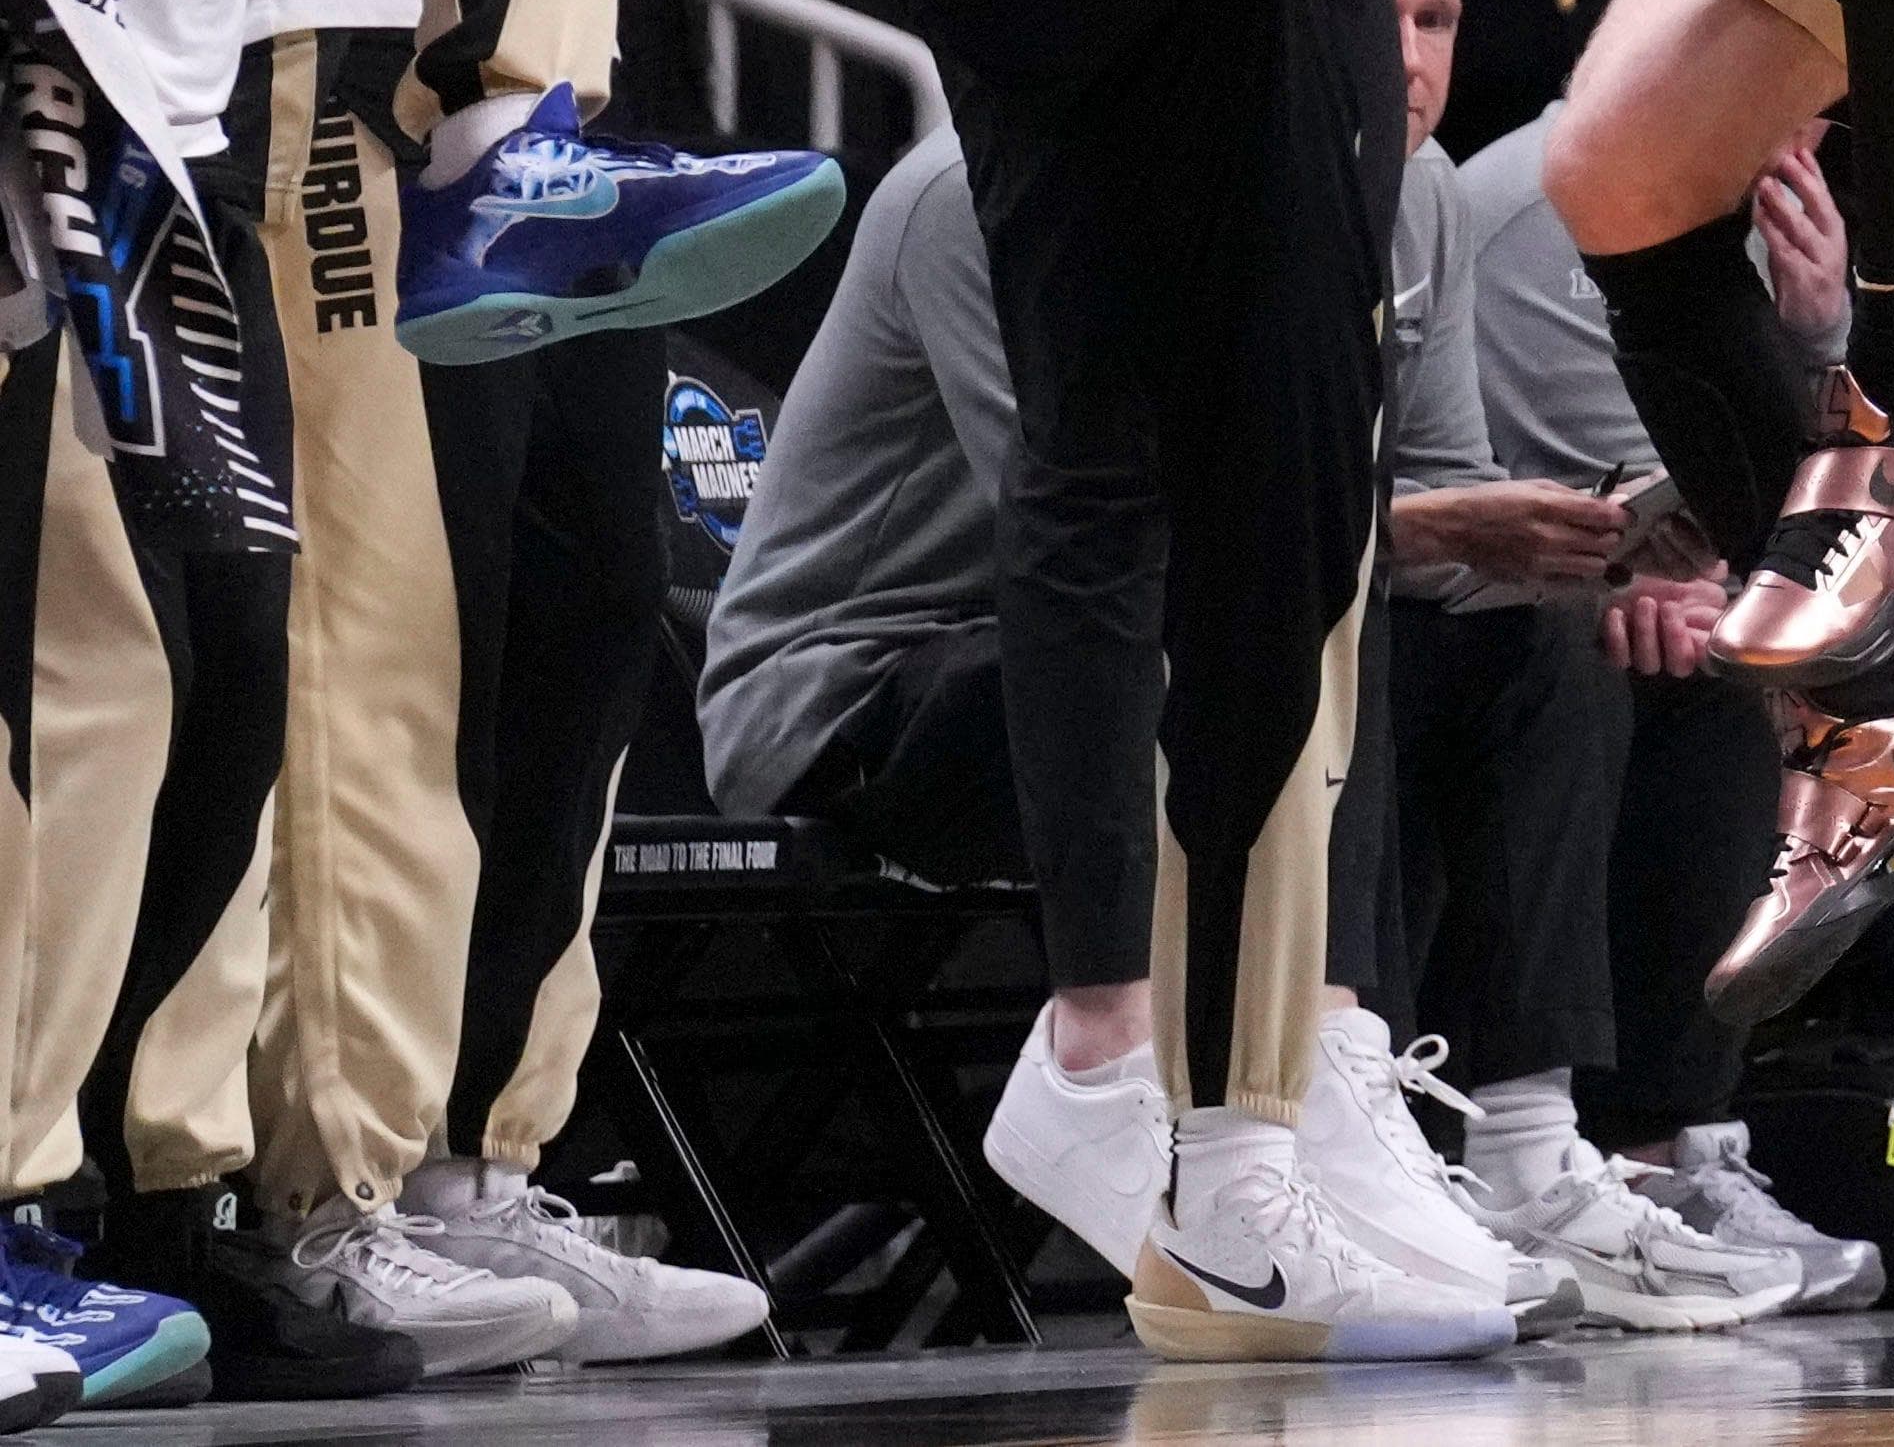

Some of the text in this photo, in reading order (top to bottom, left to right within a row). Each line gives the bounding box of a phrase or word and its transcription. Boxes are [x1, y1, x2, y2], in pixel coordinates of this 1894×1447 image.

[673, 425, 737, 462] MARCH
[691, 462, 762, 499] MADNES
[614, 844, 638, 874] THE
[671, 842, 688, 871] TO
[688, 841, 711, 871] THE
[711, 841, 744, 870] FINAL
